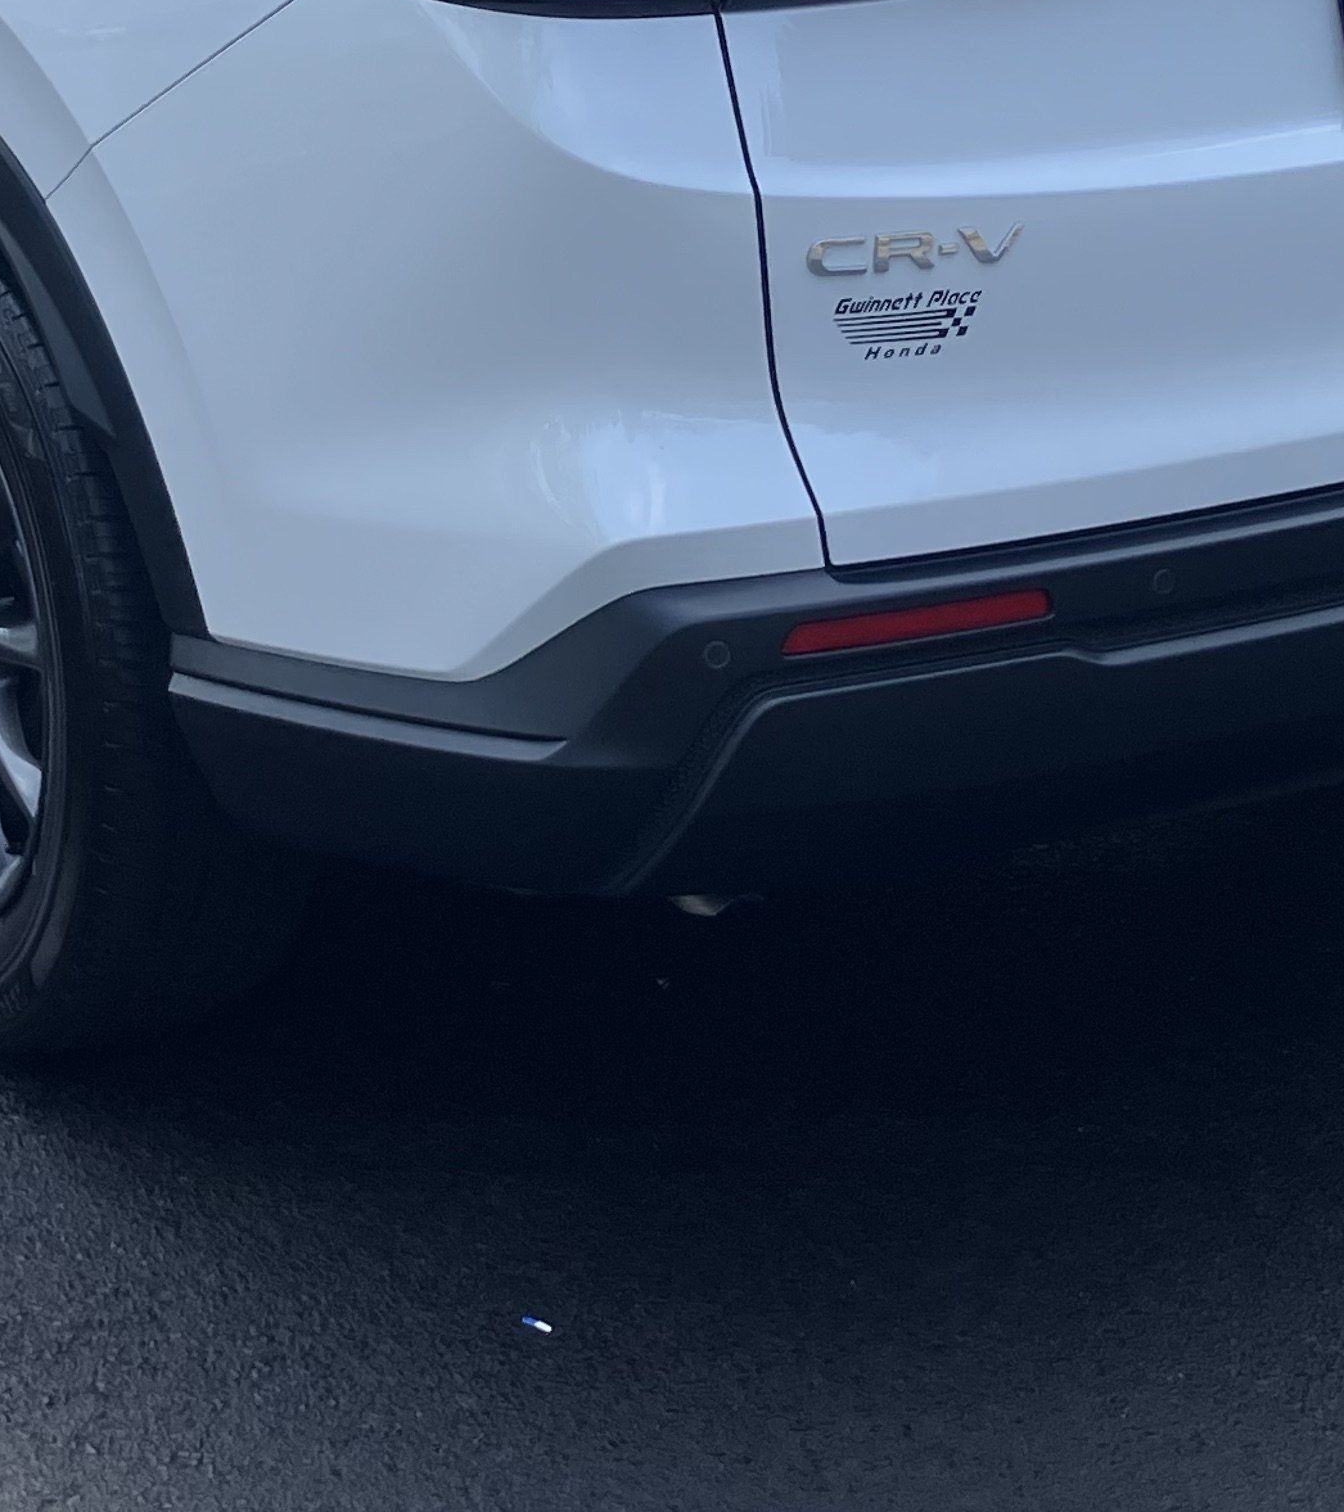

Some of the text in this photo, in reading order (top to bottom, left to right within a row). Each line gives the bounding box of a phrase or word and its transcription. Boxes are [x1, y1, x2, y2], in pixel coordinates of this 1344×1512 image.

[806, 221, 1024, 276] CR-V
[834, 290, 982, 315] Gwinnett Place
[865, 343, 942, 360] Honda
